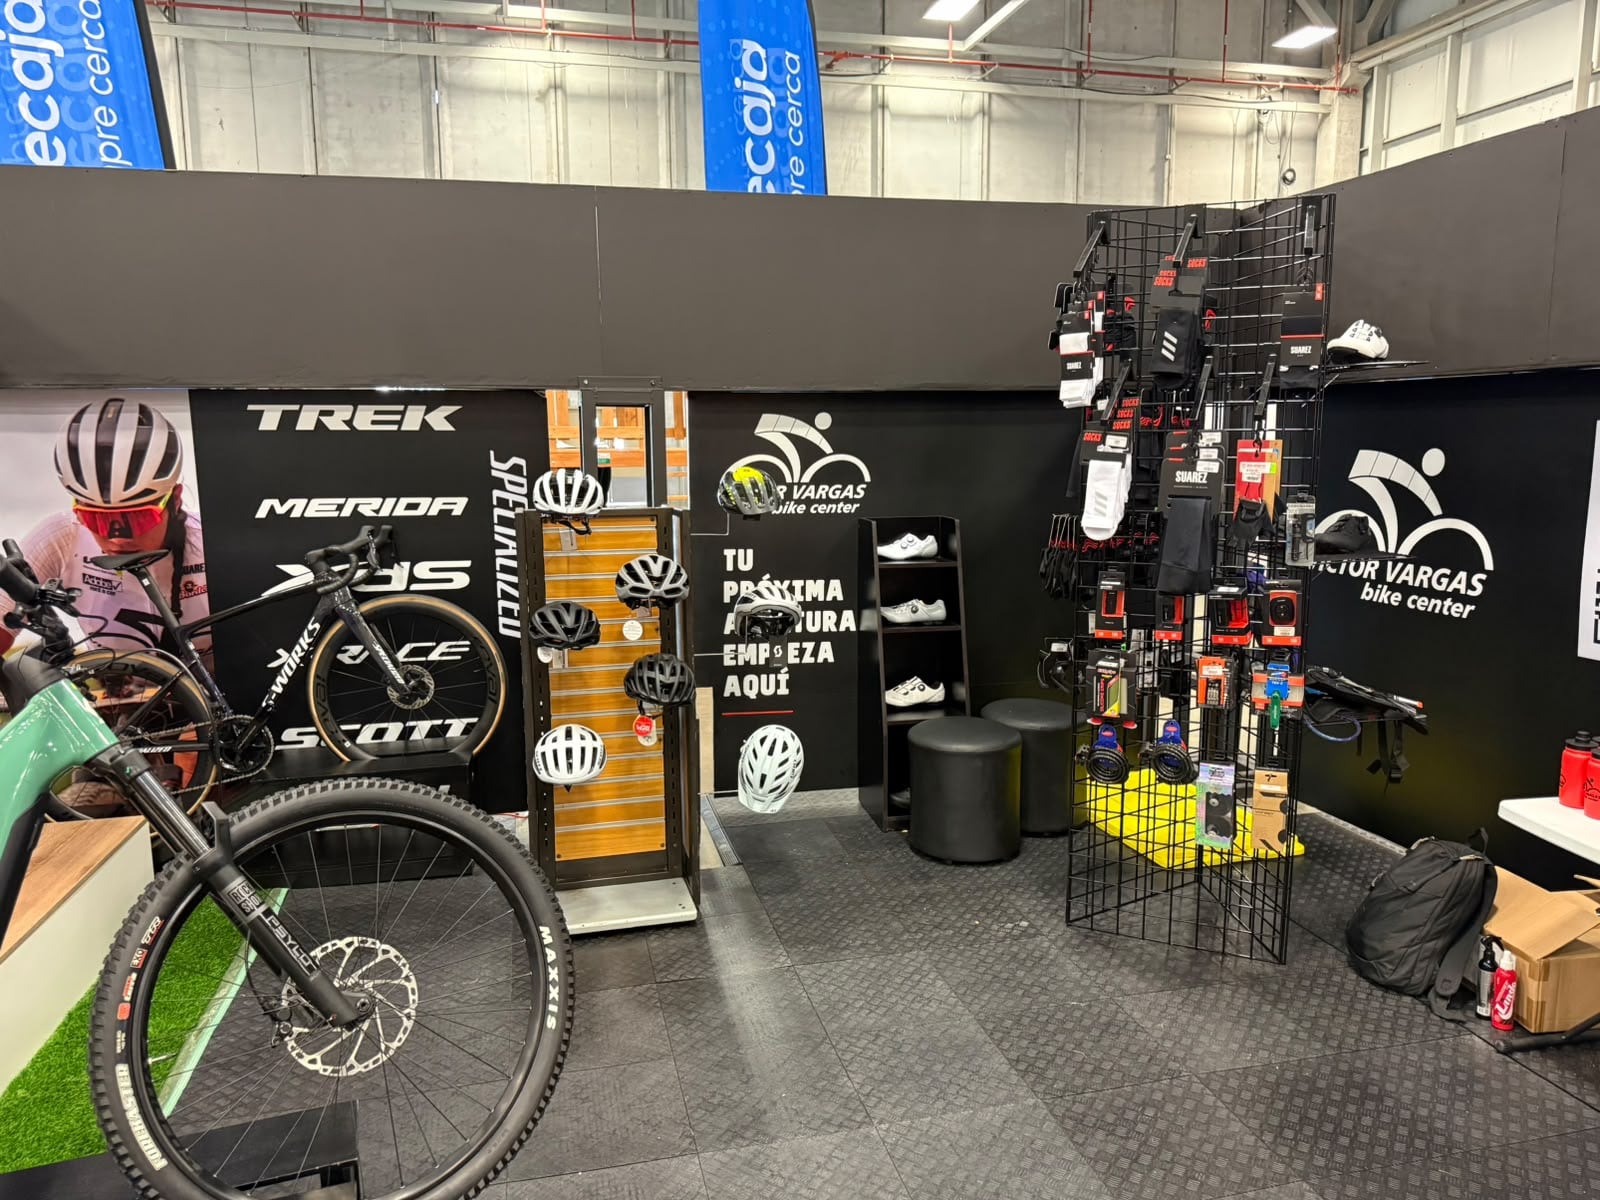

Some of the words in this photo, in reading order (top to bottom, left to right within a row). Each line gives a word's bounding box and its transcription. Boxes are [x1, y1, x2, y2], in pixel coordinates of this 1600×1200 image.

[79, 0, 113, 95] cerca
[784, 50, 803, 147] cerca
[94, 106, 133, 167] pre
[247, 404, 463, 431] TREK
[792, 484, 868, 500] VARGAS
[1175, 470, 1208, 484] SUAREZ
[255, 497, 469, 519] MERIDA
[809, 501, 860, 514] center
[489, 450, 529, 638] SPECIALIZED
[723, 548, 754, 572] TU
[184, 563, 206, 575] UARE
[1386, 560, 1488, 598] VARGAS
[1360, 582, 1402, 607] bike
[1406, 594, 1477, 620] center
[262, 617, 321, 709] S-WORKS
[723, 641, 835, 666] EMPEZA
[723, 666, 790, 700] AQUÍ
[130, 948, 147, 968] EXO
[265, 914, 312, 967] PSYLO
[538, 926, 557, 1030] MAXXIS
[115, 1064, 168, 1171] FOREKASTER
